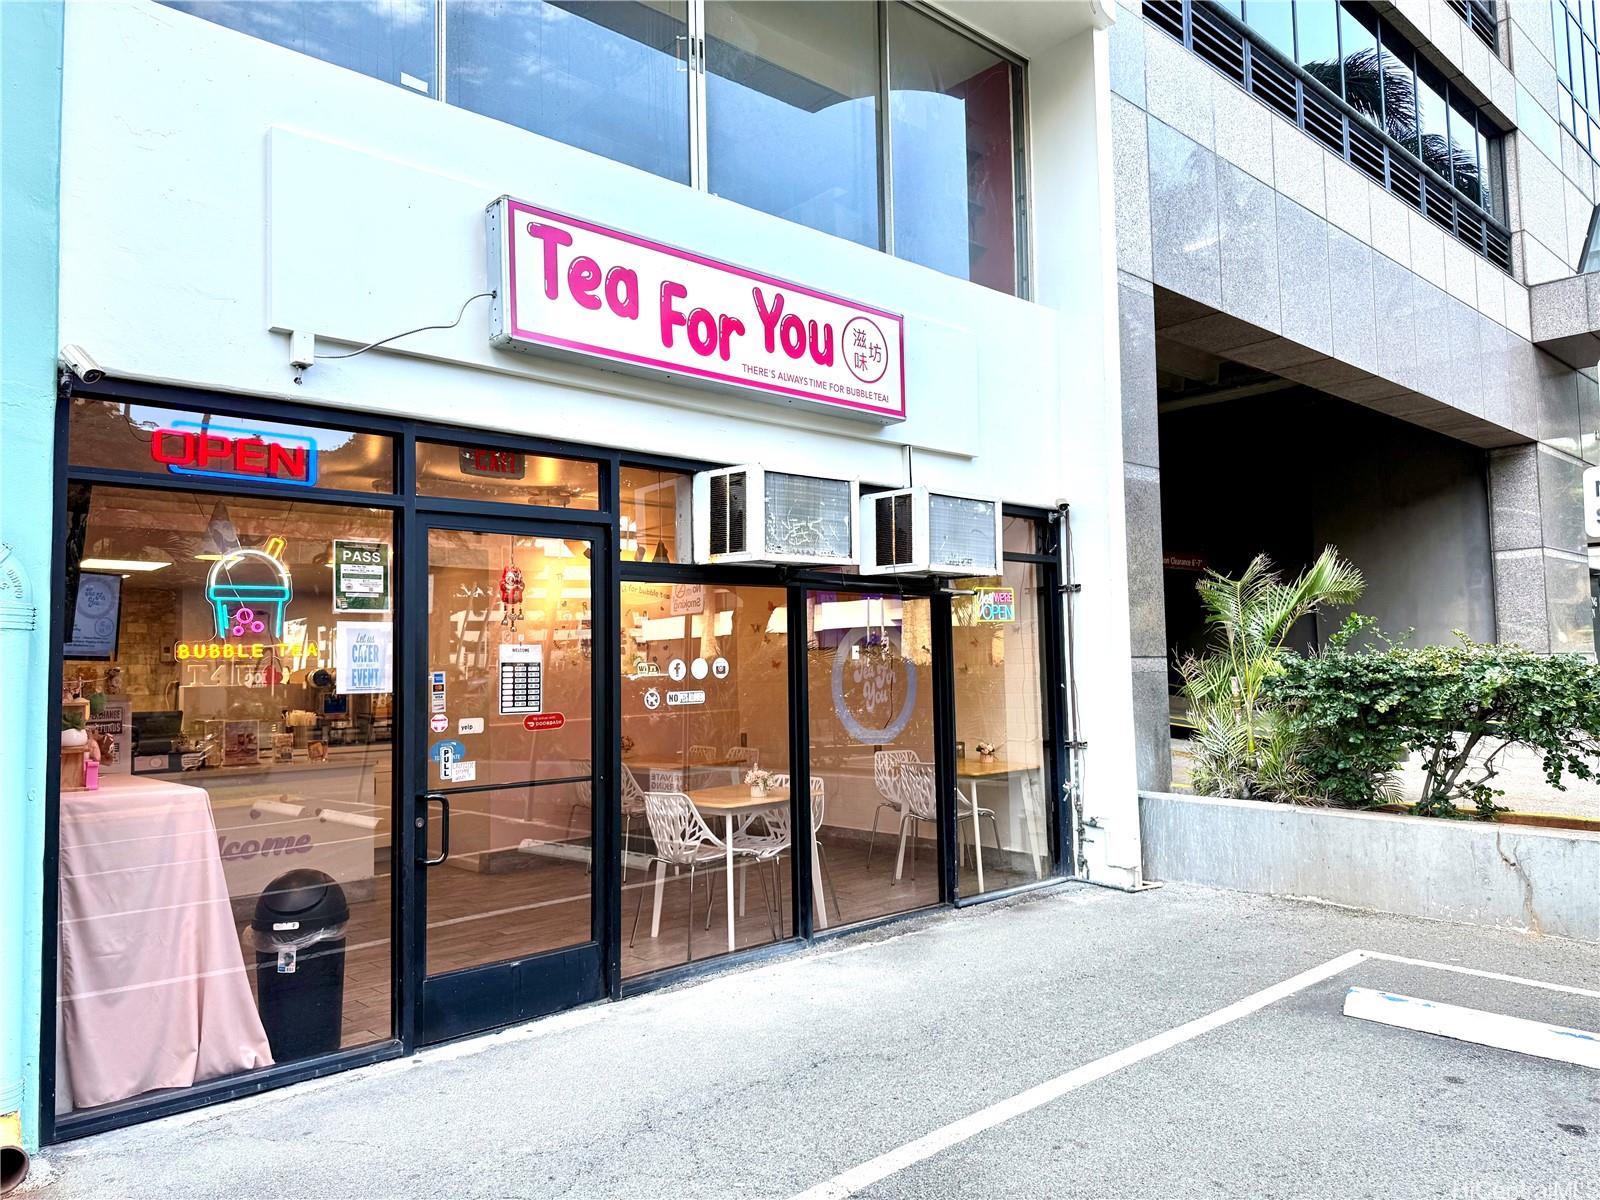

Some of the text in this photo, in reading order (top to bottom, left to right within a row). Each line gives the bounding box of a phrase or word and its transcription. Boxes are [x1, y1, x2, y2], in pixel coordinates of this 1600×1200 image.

[527, 222, 833, 367] Tea For You
[742, 363, 889, 403] THERE'S ALWAYS TIME FOR BUBBLE TEA!
[151, 428, 305, 478] OPEN
[343, 551, 381, 563] PASS
[982, 604, 1012, 620] OPEN
[177, 643, 318, 659] BUBBLE TEA
[352, 645, 379, 663] CATER
[352, 668, 379, 687] EVENT
[669, 694, 678, 703] NO
